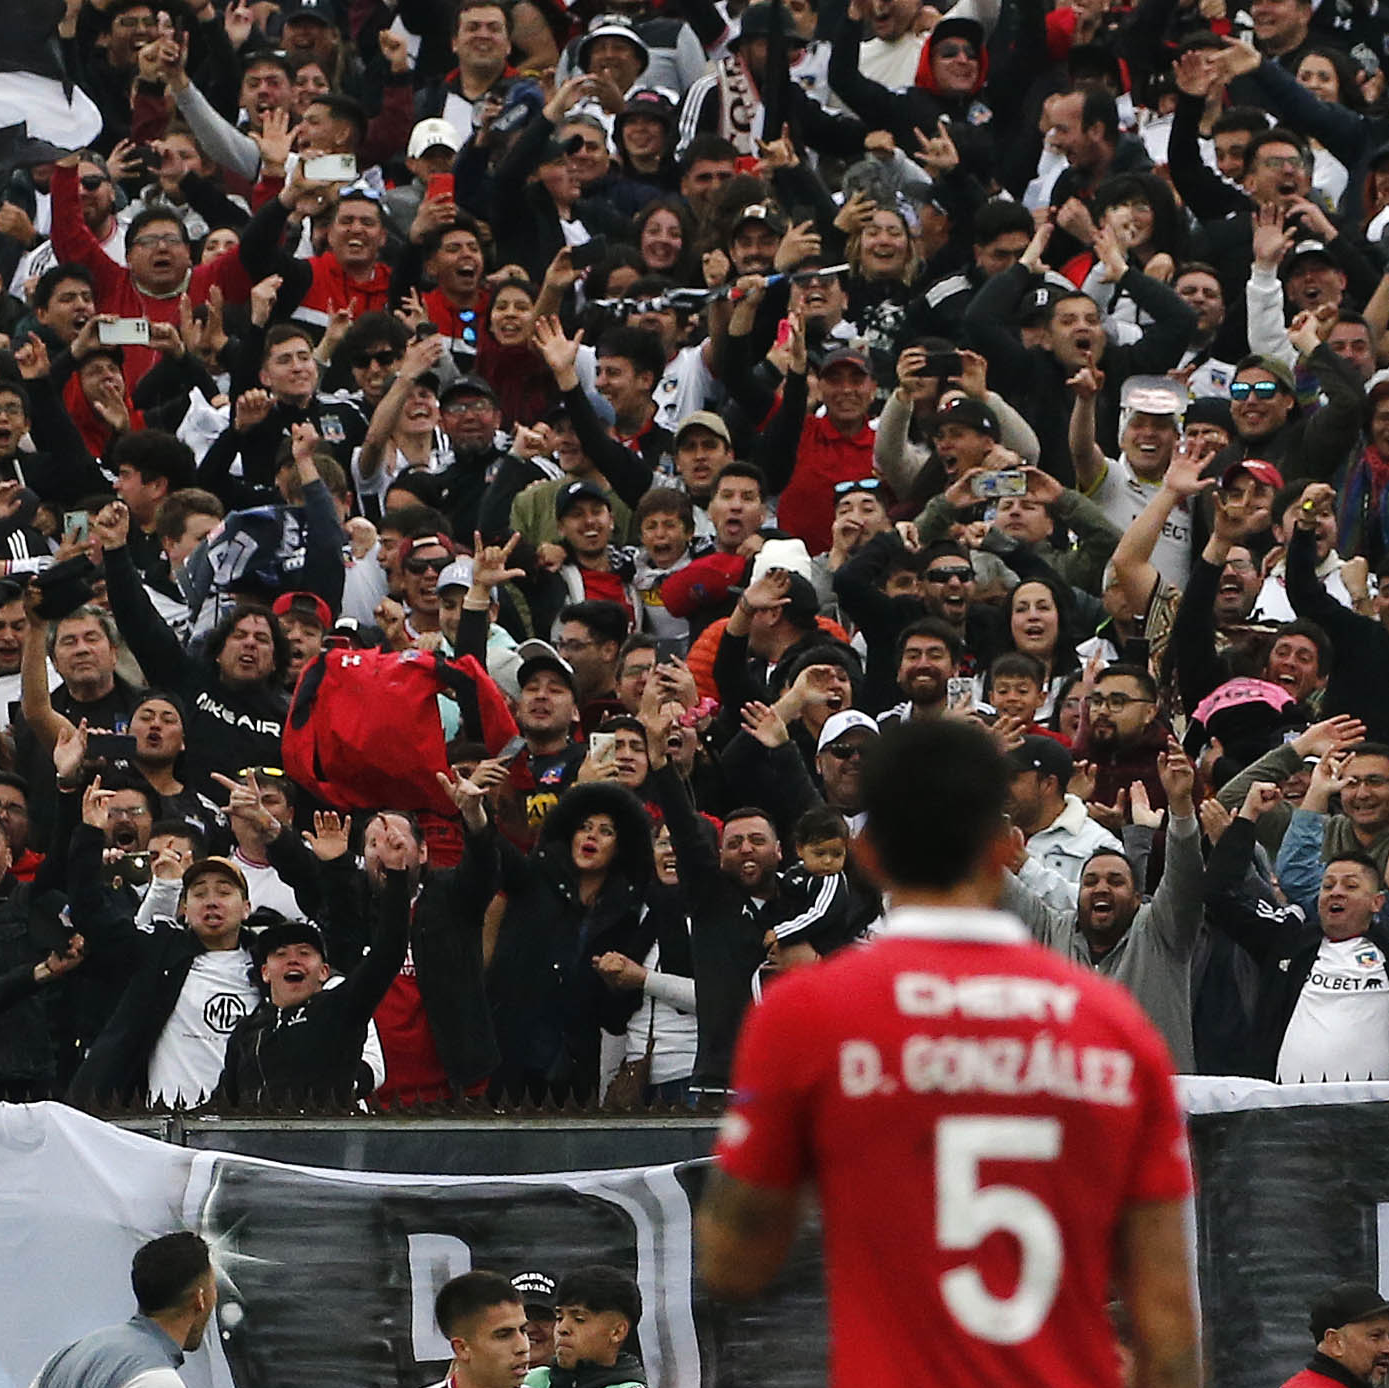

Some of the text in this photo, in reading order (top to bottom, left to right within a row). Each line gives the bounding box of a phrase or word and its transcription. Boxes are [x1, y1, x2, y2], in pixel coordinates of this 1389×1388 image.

[237, 715, 281, 738] AIR
[1307, 973, 1362, 991] OLBET
[838, 1029, 1135, 1107] D. GONZÁLEZ
[936, 1114, 1065, 1346] 5
